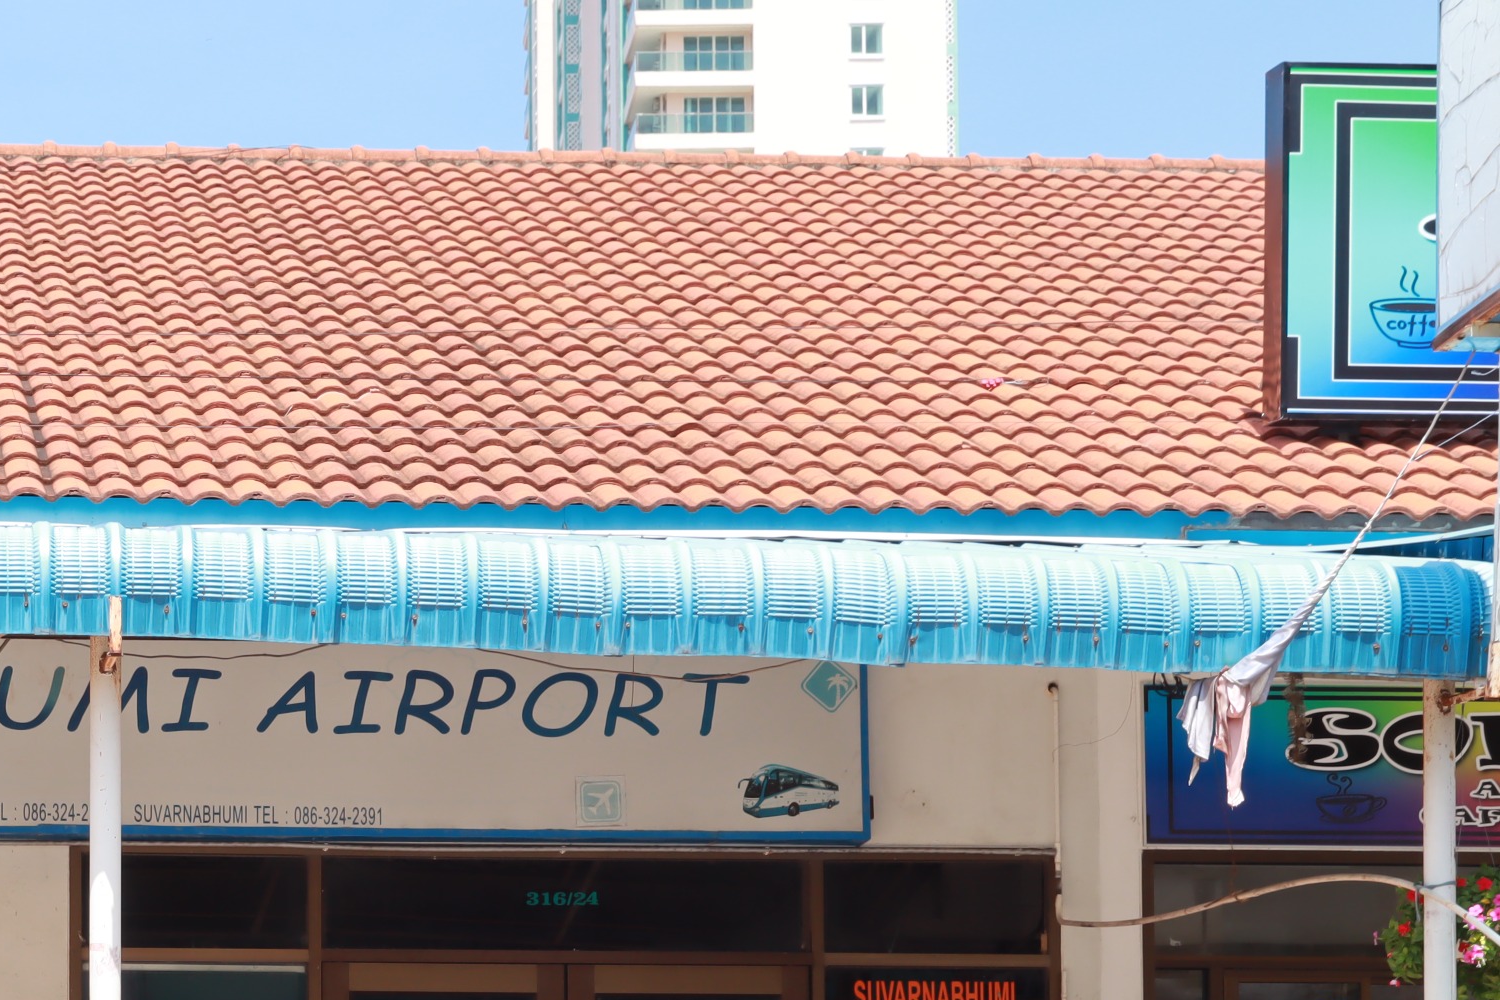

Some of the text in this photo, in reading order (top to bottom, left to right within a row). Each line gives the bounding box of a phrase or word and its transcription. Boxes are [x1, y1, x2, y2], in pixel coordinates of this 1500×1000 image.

[257, 669, 750, 737] AIRPORT
[23, 802, 89, 822] 086-324-2
[134, 803, 248, 824] SUVARNABHUMI
[254, 804, 280, 825] TEL
[293, 805, 383, 826] 086-324-2391
[526, 891, 600, 906] 316/24
